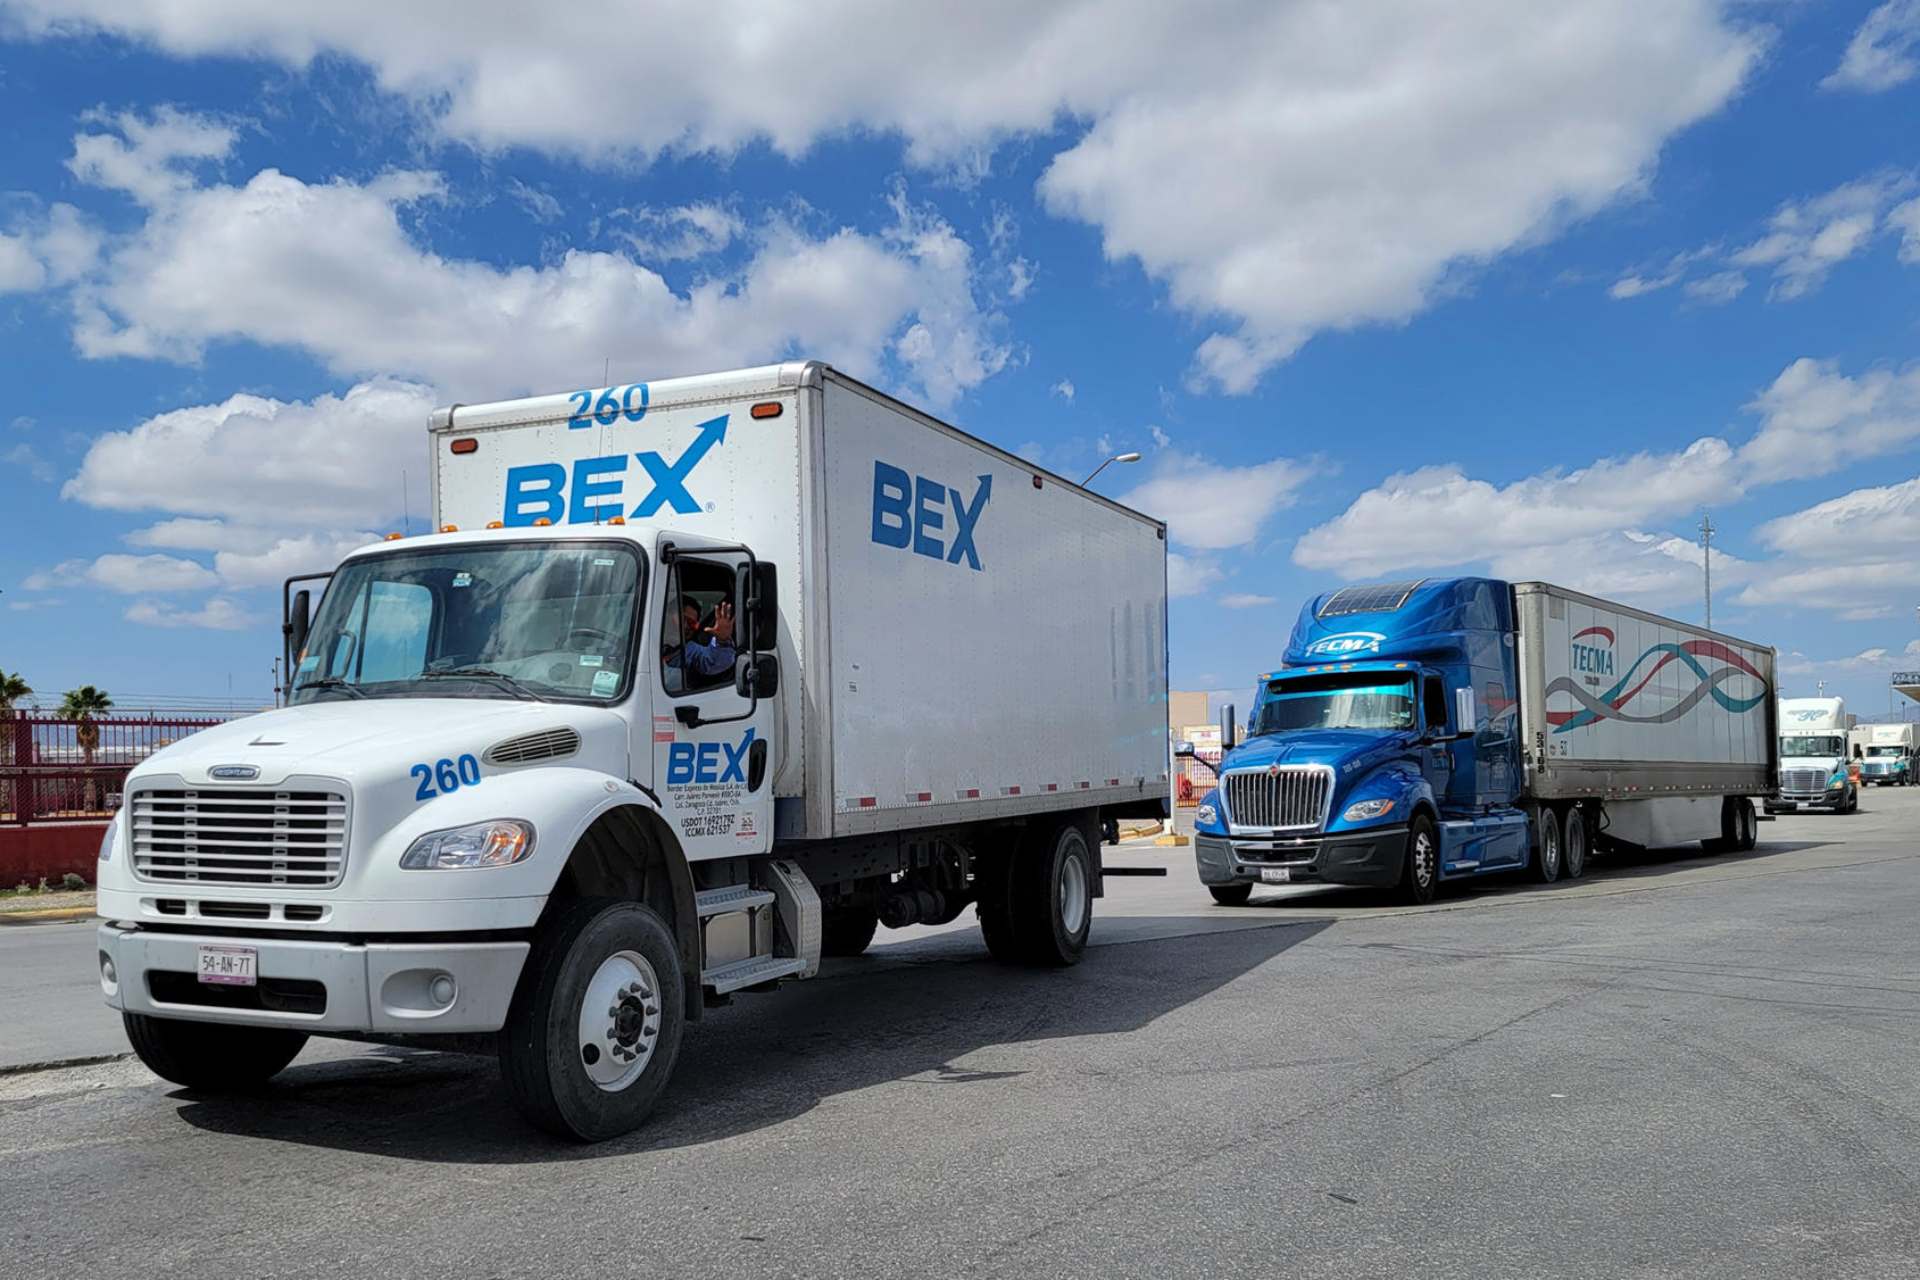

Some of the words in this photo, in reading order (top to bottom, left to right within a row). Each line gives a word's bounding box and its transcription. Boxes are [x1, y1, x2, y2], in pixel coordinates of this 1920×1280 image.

[568, 383, 649, 430] 260
[502, 414, 730, 527] BEX
[871, 459, 993, 572] BEX
[1572, 643, 1614, 676] TECMA
[411, 754, 481, 801] 260
[667, 727, 755, 784] BEX
[681, 817, 703, 828] USDOT
